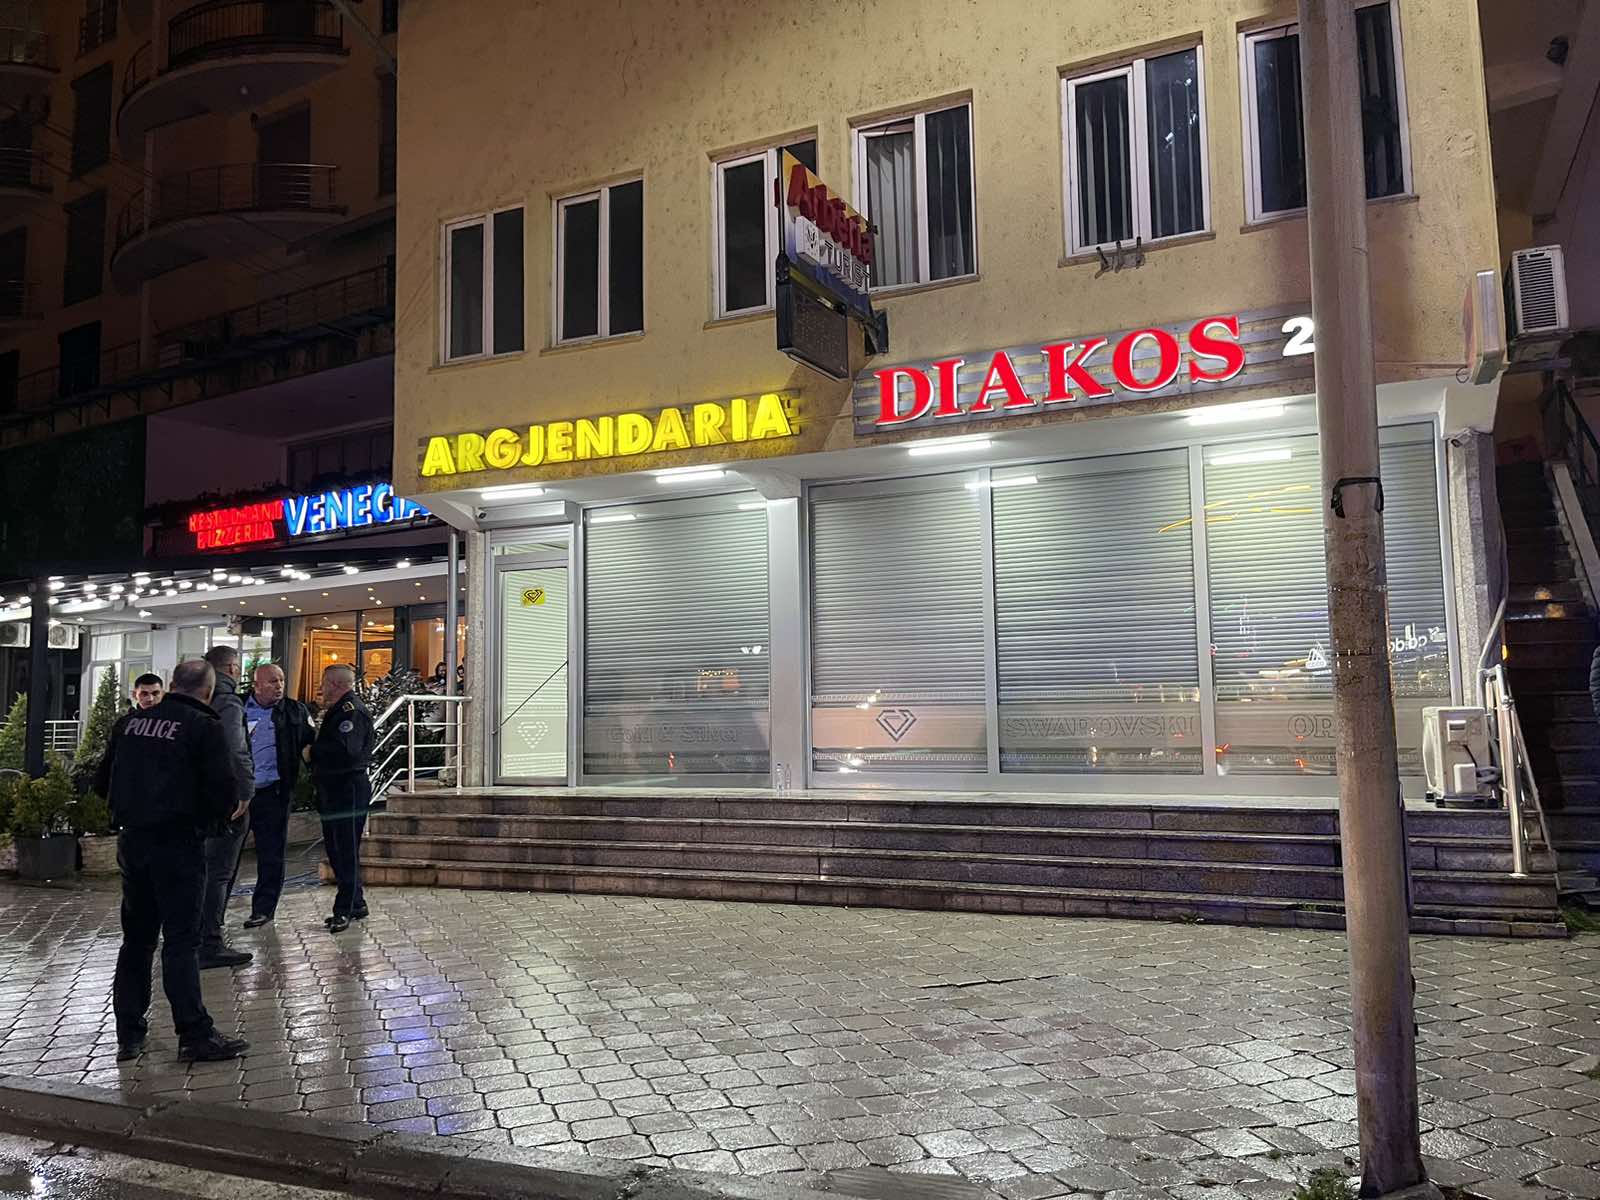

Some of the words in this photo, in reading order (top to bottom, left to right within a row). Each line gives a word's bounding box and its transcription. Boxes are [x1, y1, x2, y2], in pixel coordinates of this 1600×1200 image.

[873, 315, 1246, 425] DIAKOS
[1281, 316, 1315, 357] 2
[421, 393, 792, 477] ARGJENDARIA
[197, 523, 275, 549] PIZZERIA
[124, 717, 182, 740] POLICE
[1006, 713, 1196, 738] SWAROVSKI
[1288, 713, 1337, 738] OR
